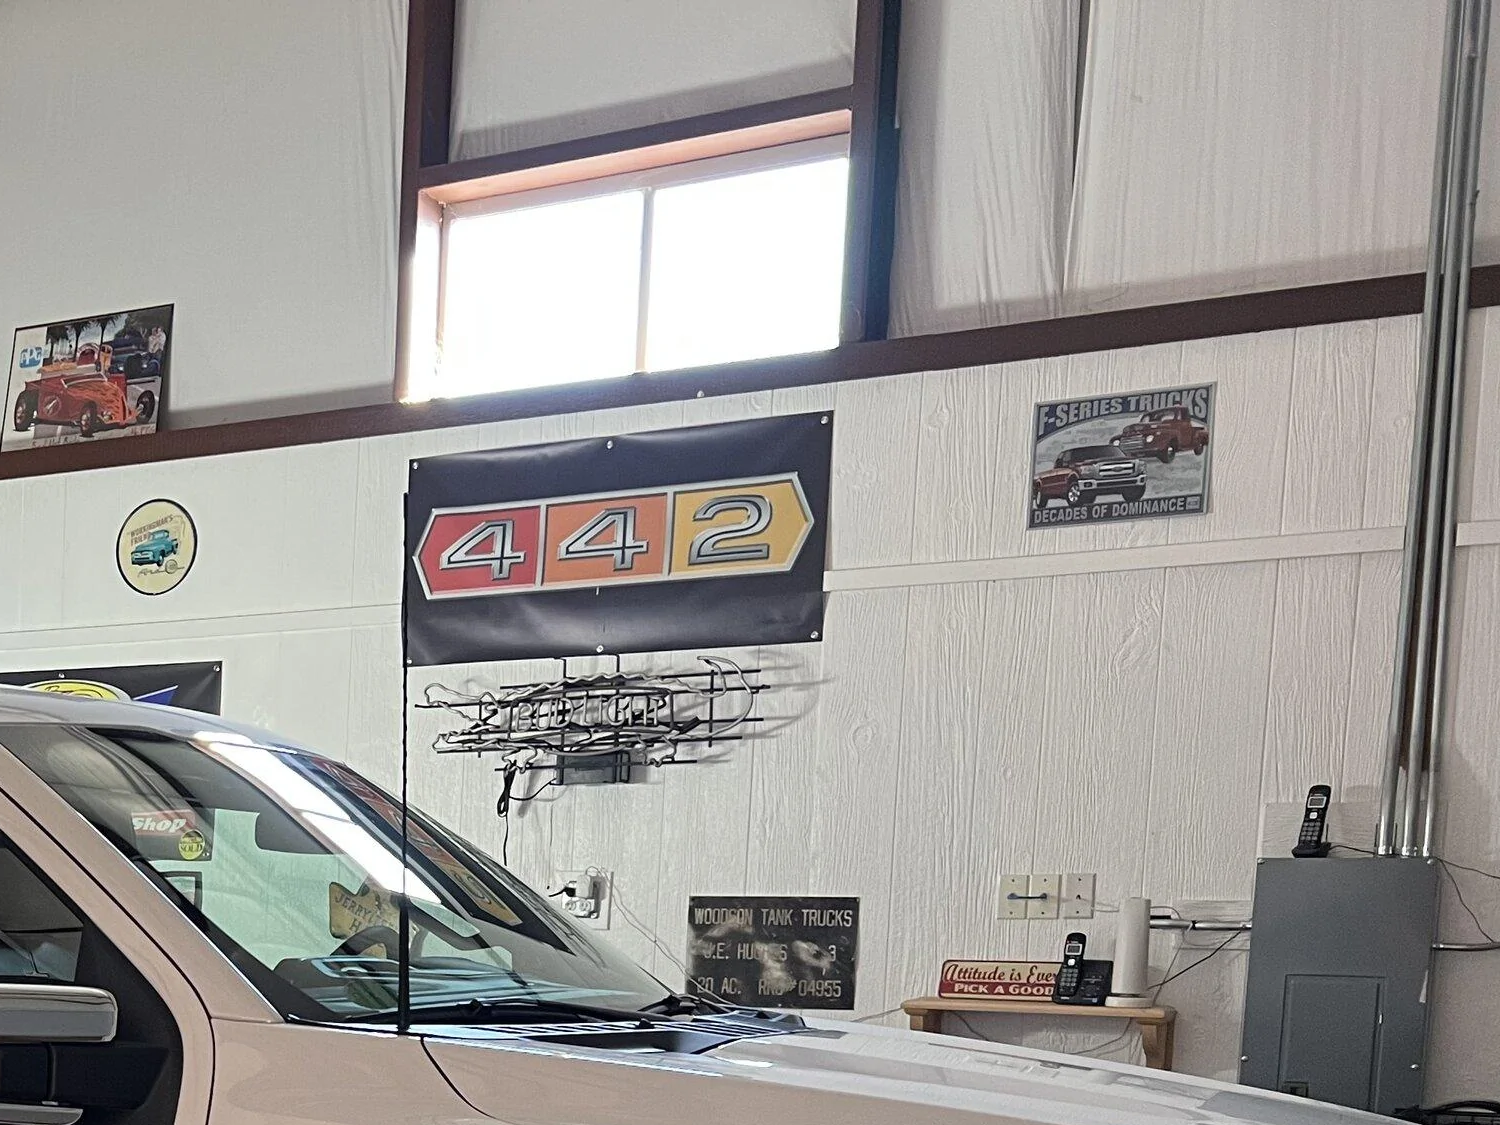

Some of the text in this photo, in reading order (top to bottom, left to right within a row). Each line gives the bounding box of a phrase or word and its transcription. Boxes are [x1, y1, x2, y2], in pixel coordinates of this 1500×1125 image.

[1038, 388, 1209, 436] F-SERIES TRUCKS
[1033, 498, 1185, 524] DECADES OF DOMINANCE
[132, 817, 187, 834] Shop
[694, 908, 853, 927] WOODSON TANK TRUCKS
[943, 963, 1005, 982] Attitude
[1009, 968, 1022, 982] is
[798, 980, 842, 998] 04955
[954, 984, 989, 995] PICK
[994, 984, 1005, 995] A
